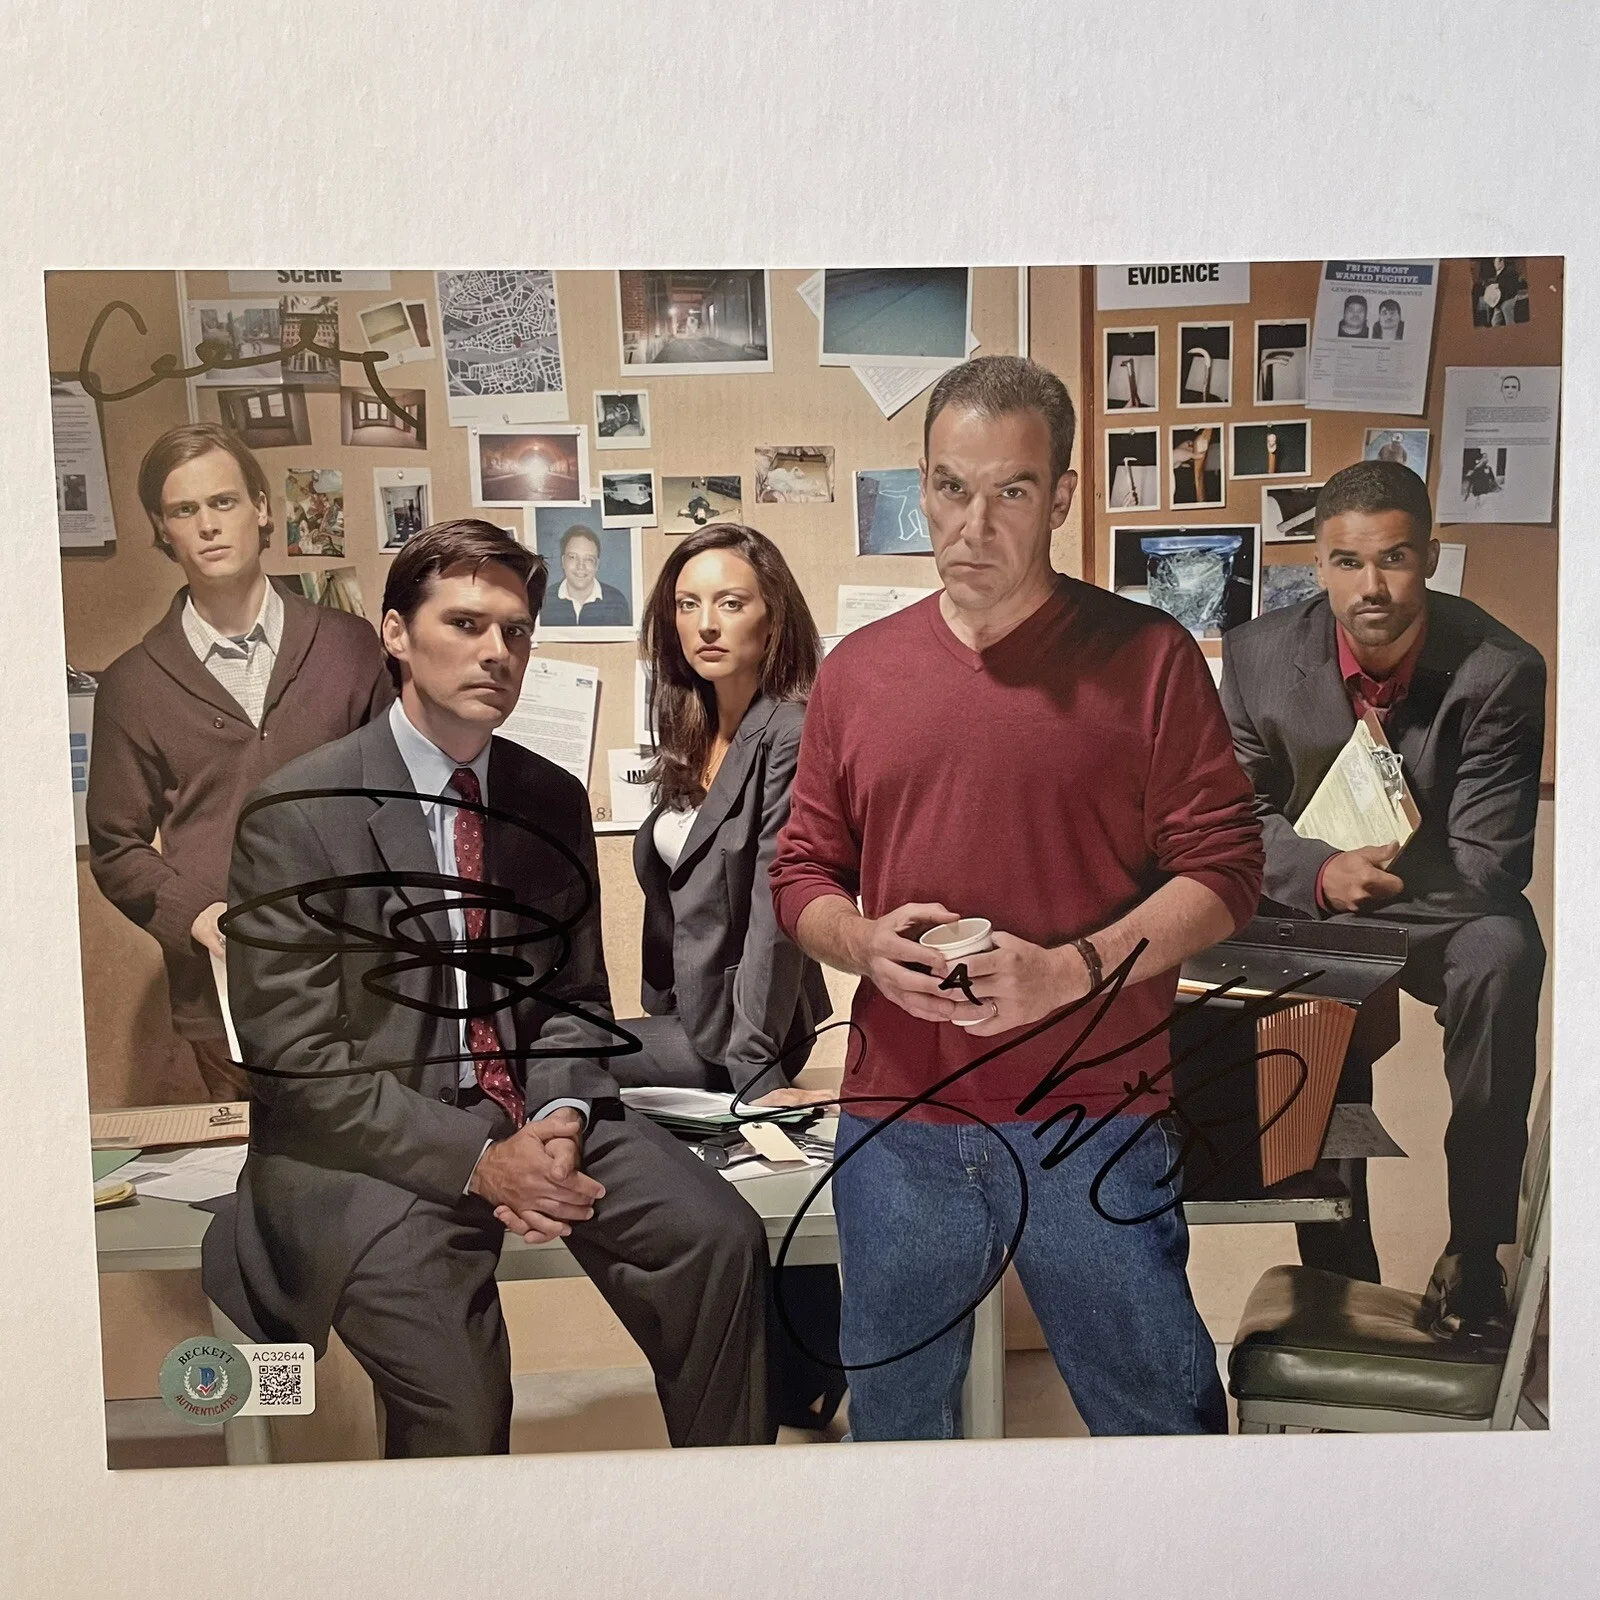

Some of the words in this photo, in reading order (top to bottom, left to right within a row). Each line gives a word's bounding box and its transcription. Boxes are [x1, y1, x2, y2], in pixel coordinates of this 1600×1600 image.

[1128, 263, 1219, 285] EVIDENCE
[1346, 264, 1360, 272] FBI
[1362, 265, 1380, 273] TEN
[1382, 266, 1409, 274] MOST
[277, 270, 342, 283] SCENE
[1335, 272, 1373, 281] WANTED
[1375, 274, 1419, 283] FUGITIVE
[178, 1346, 235, 1366] BECKETT
[252, 1352, 305, 1362] AC32644
[175, 1394, 239, 1416] AUTHENTICATED
